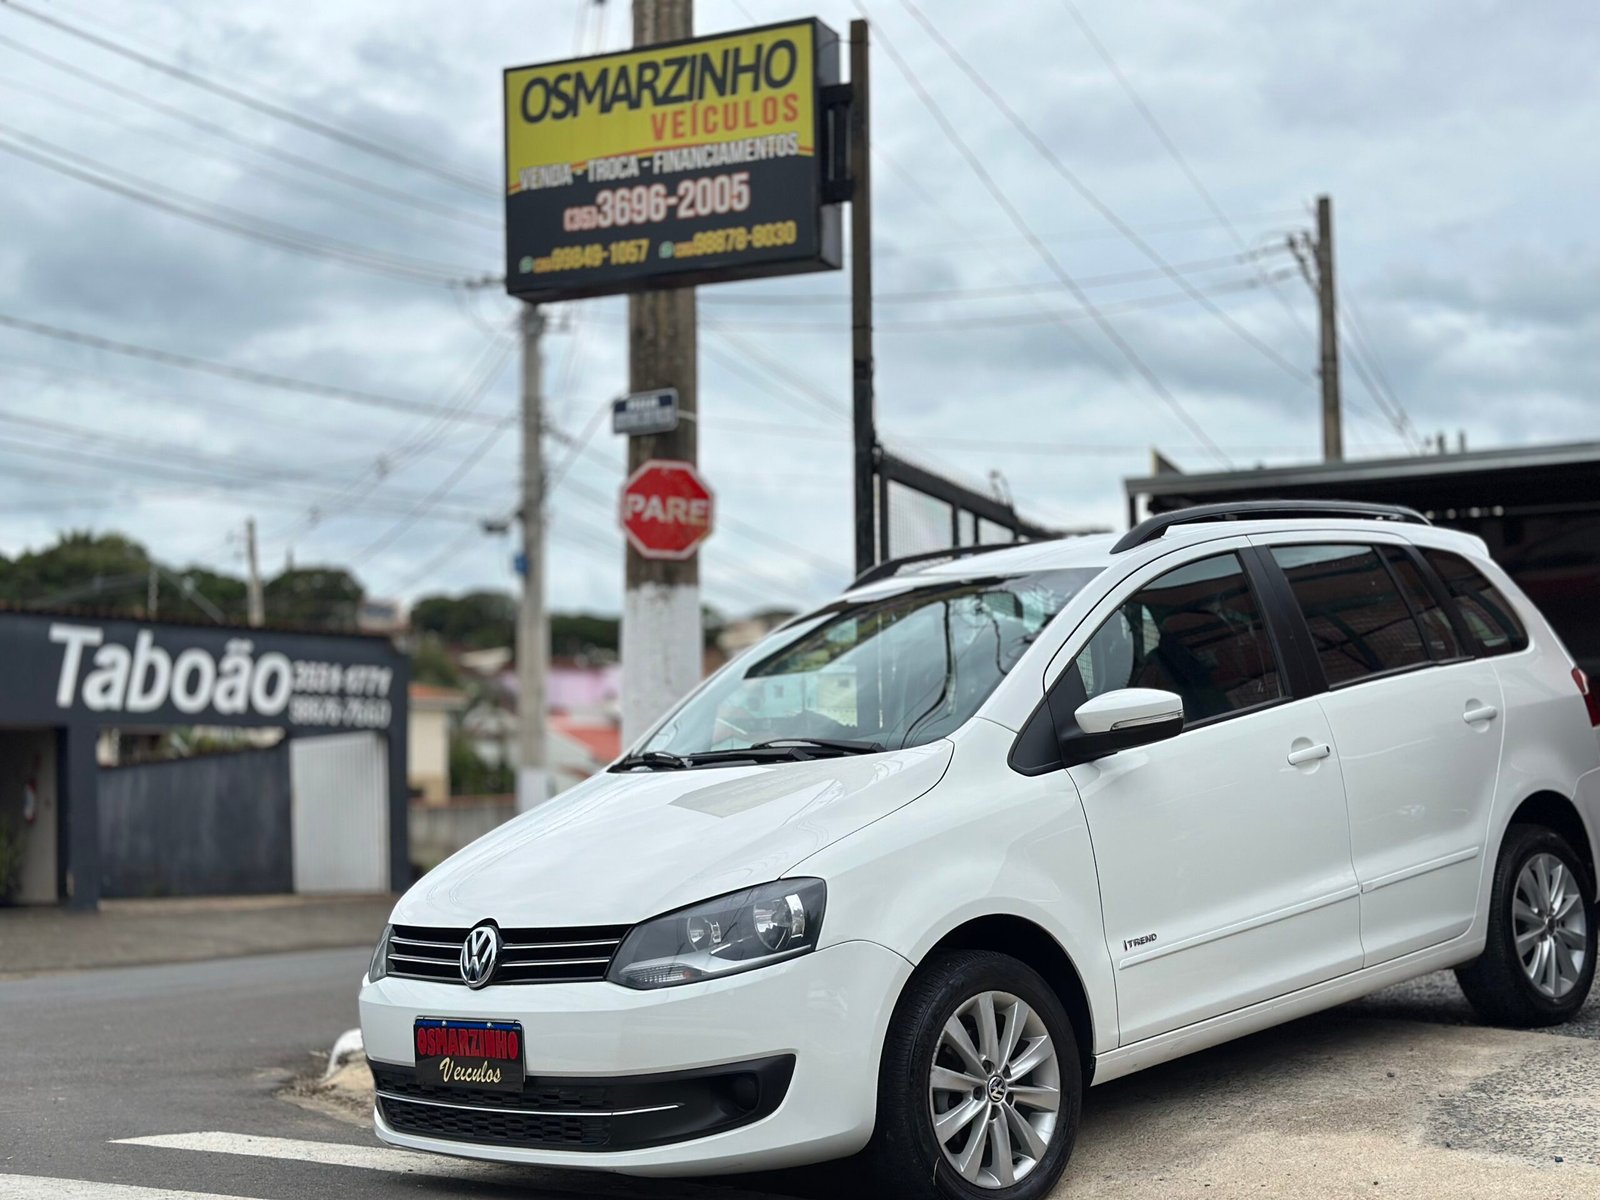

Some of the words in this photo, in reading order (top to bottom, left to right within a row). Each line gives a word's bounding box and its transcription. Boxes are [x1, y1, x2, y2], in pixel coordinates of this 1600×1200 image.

[520, 38, 798, 124] OSMARZINHO
[650, 93, 799, 141] VEÍCULOS
[519, 164, 573, 191] VENDA
[588, 155, 640, 183] TROCA
[653, 132, 798, 174] FINANCIAMENTOS
[624, 493, 709, 526] PARE
[48, 623, 292, 715] Taboão
[417, 1027, 519, 1060] OSMARZINHO
